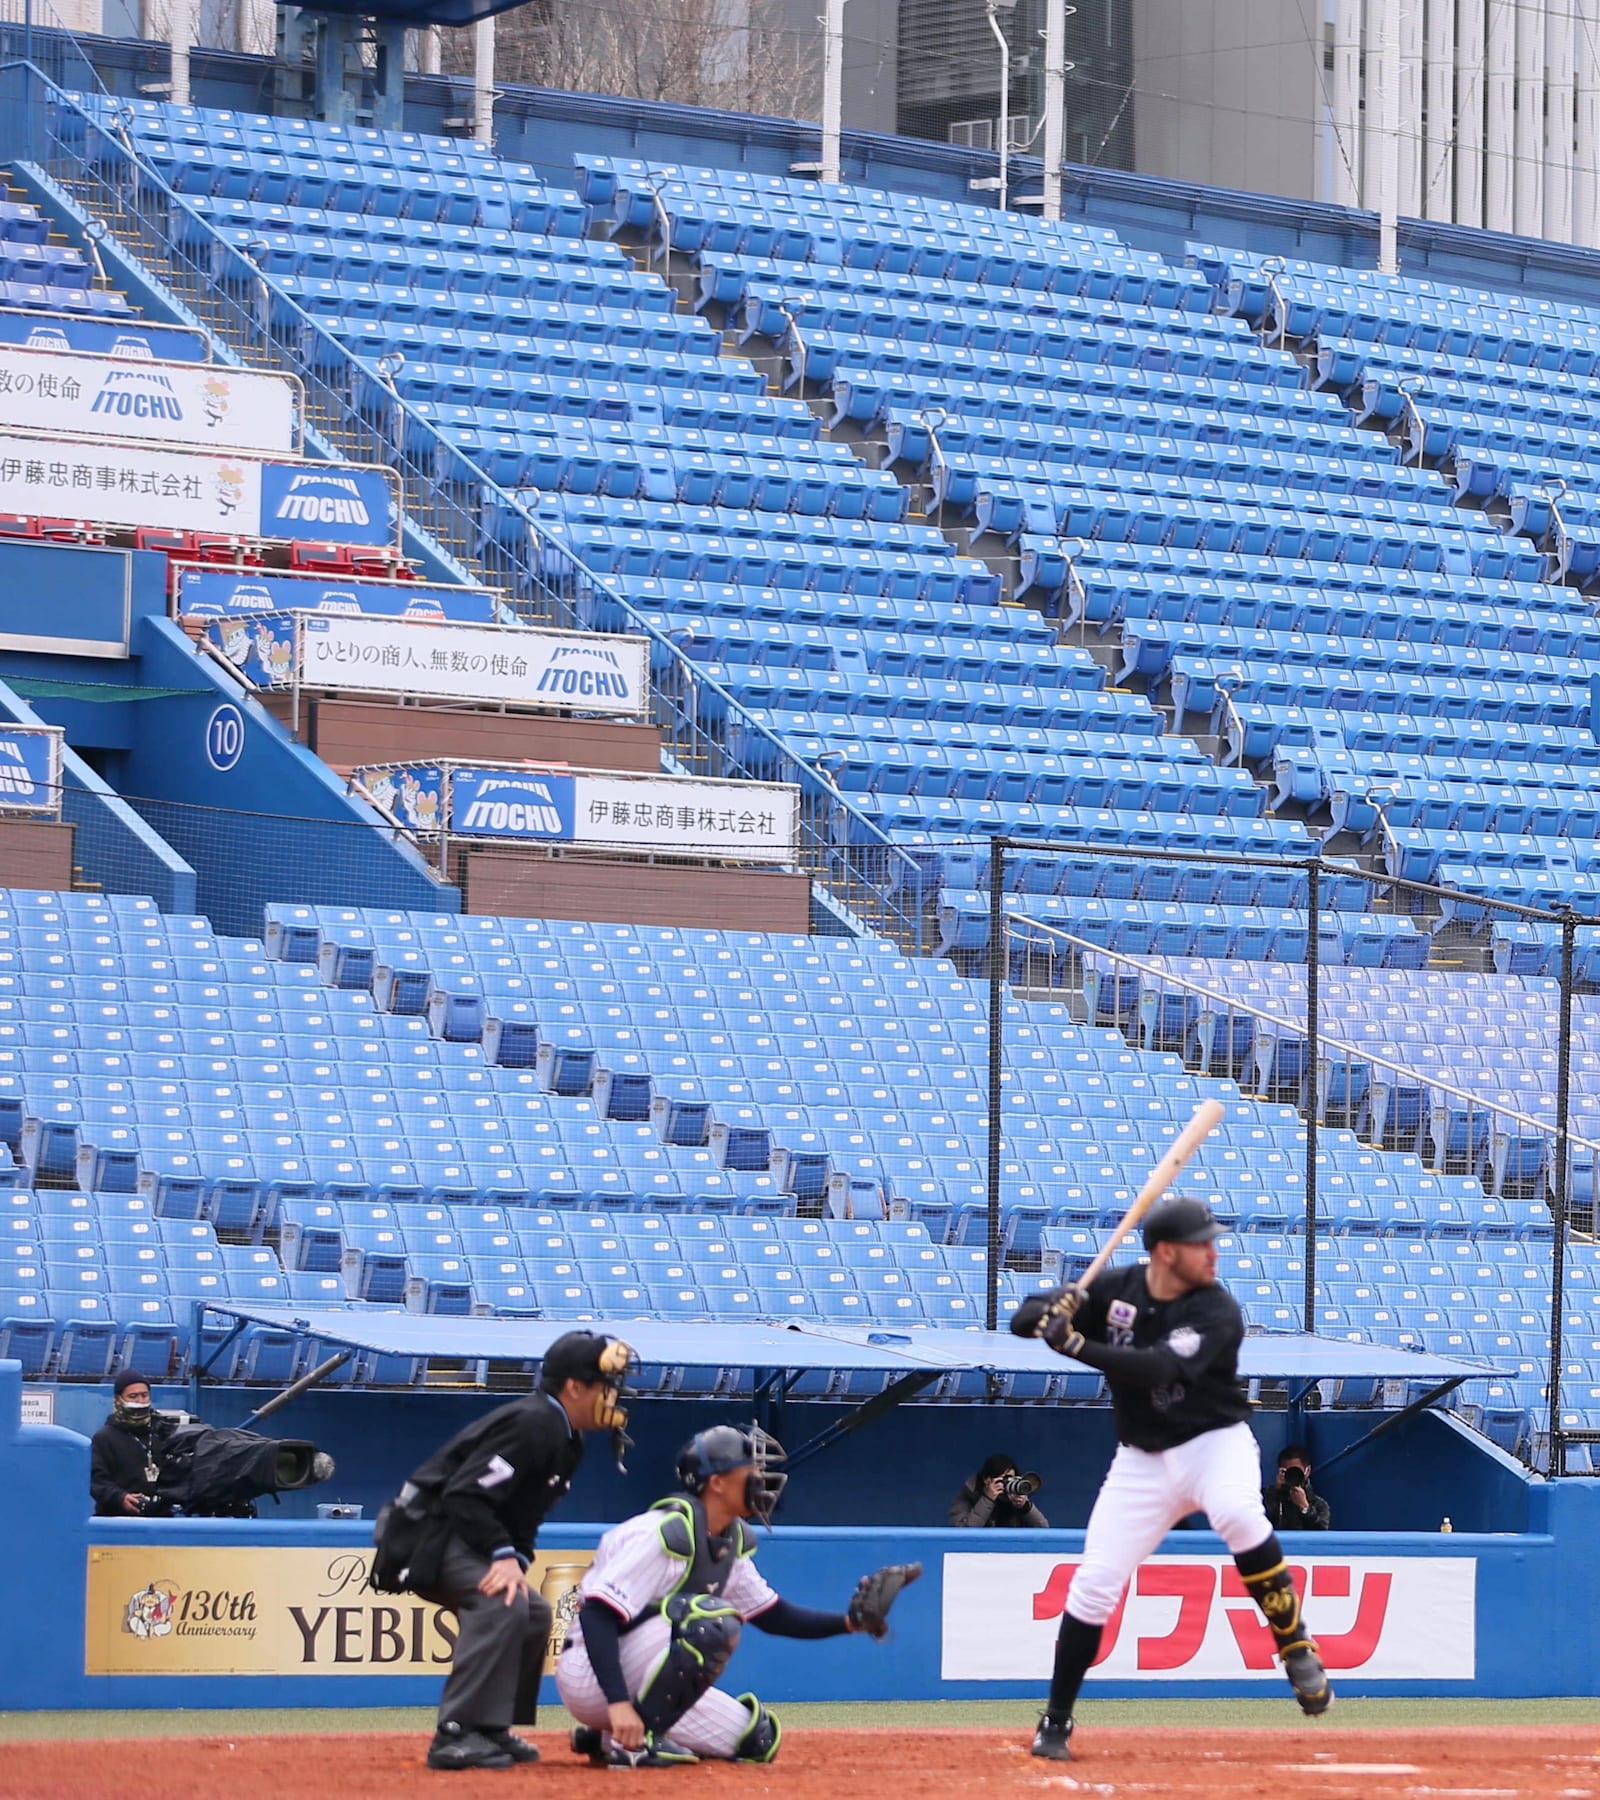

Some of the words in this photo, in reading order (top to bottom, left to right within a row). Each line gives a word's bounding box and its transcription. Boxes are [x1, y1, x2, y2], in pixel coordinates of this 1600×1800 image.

[91, 390, 184, 421] ITOCHU
[0, 457, 203, 500] 伊藤忠商事株式会社
[276, 494, 370, 526] ITOCHU
[228, 594, 275, 610] ITOCHU
[316, 640, 529, 679] ひとりの商人、無数の使命
[536, 667, 629, 698] ITOCHU
[215, 719, 239, 755] 10
[463, 801, 562, 834] ITOCHU
[588, 798, 777, 836] 伊藤忠商事株式会社
[477, 1454, 516, 1489] 7
[179, 1590, 258, 1622] 130th
[176, 1622, 258, 1641] Anniversary
